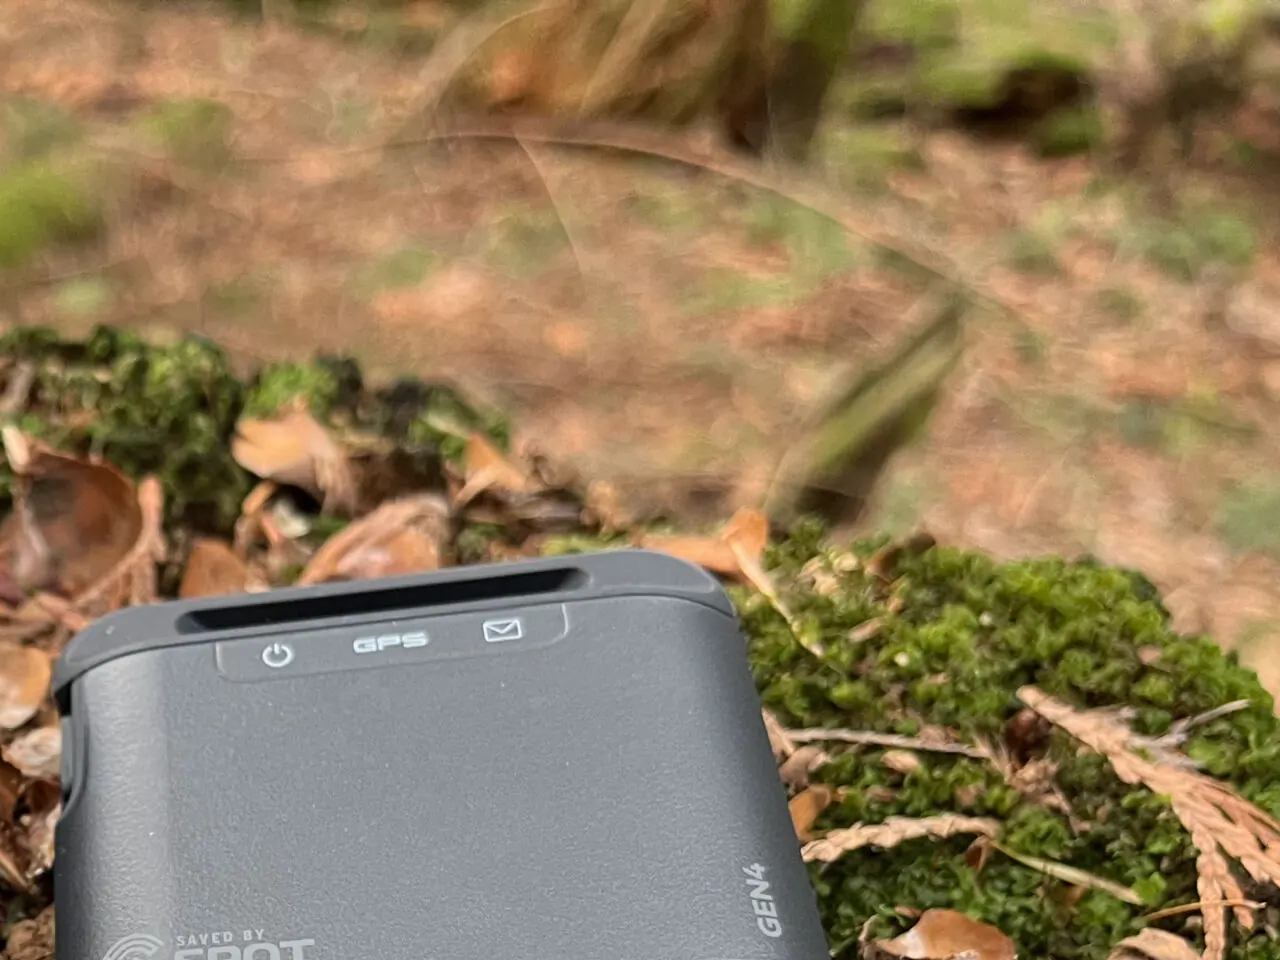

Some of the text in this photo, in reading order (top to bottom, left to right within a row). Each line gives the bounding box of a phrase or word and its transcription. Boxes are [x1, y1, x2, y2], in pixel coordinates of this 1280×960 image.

[353, 631, 429, 654] GPS
[741, 863, 782, 938] GEN4
[176, 928, 265, 946] SAVED BY
